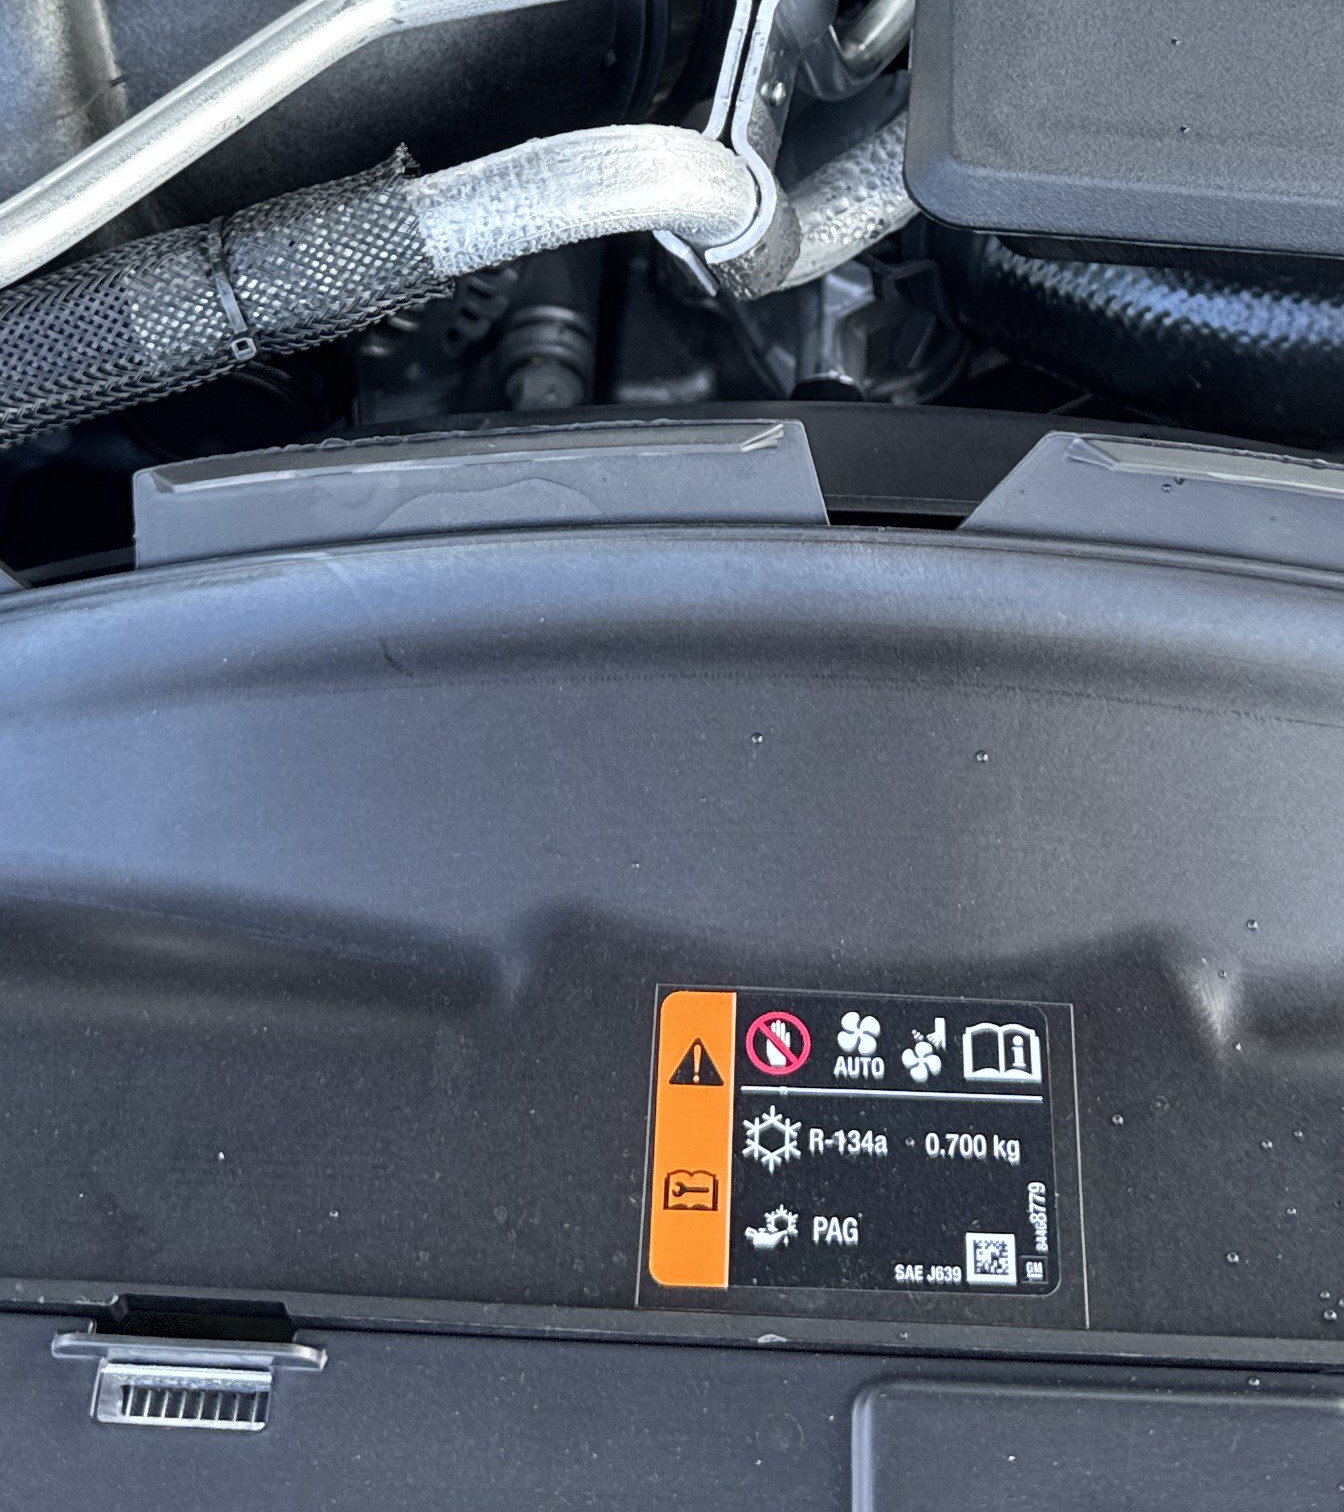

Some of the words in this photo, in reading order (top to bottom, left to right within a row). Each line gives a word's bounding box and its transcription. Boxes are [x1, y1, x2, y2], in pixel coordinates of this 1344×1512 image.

[834, 1056, 885, 1079] AUTO
[809, 1128, 888, 1154] R-134a
[925, 1132, 987, 1159] 0.700
[993, 1135, 1021, 1166] kg
[813, 1217, 859, 1246] PAG
[894, 1264, 924, 1283] SAE
[926, 1265, 962, 1284] J639
[1025, 1261, 1043, 1274] GM
